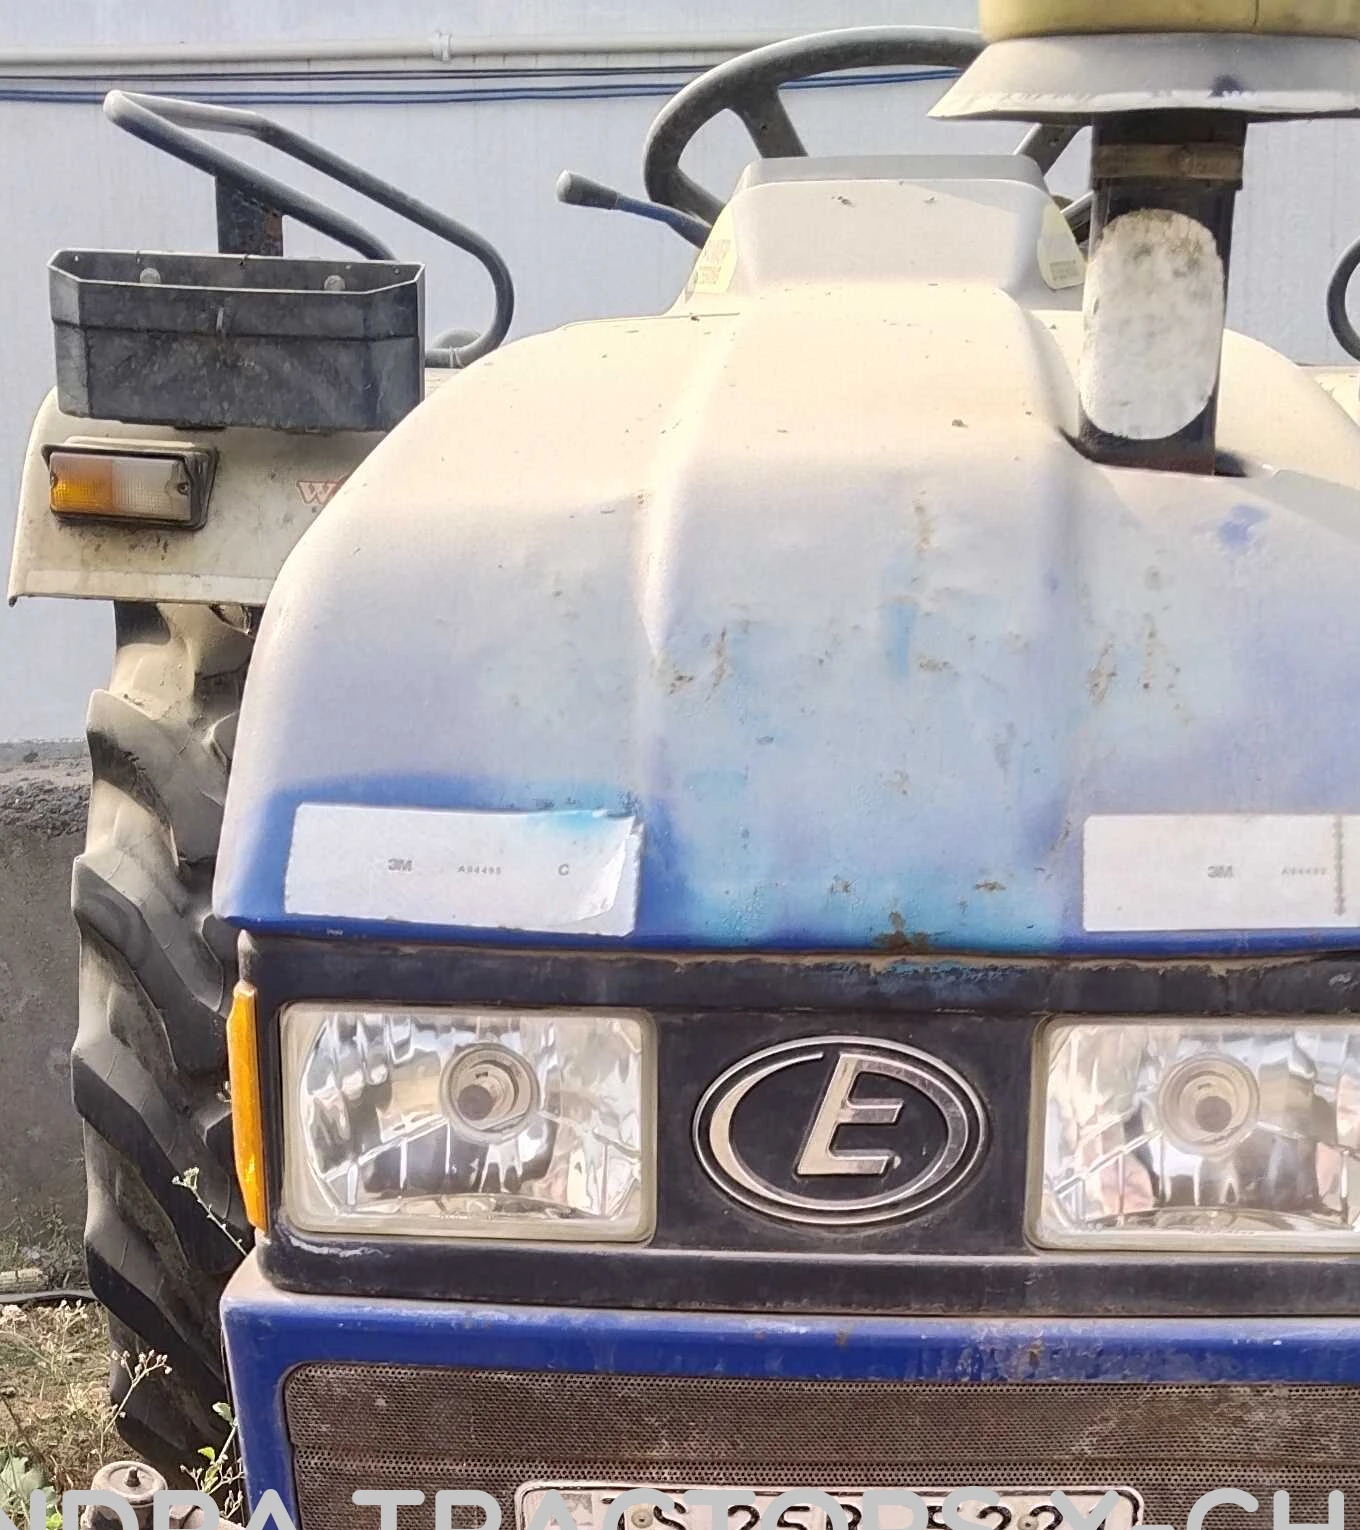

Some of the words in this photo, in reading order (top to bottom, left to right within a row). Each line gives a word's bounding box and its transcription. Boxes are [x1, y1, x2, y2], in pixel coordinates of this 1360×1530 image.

[387, 857, 413, 872] 3M
[557, 863, 570, 877] C
[1207, 864, 1234, 879] 3M
